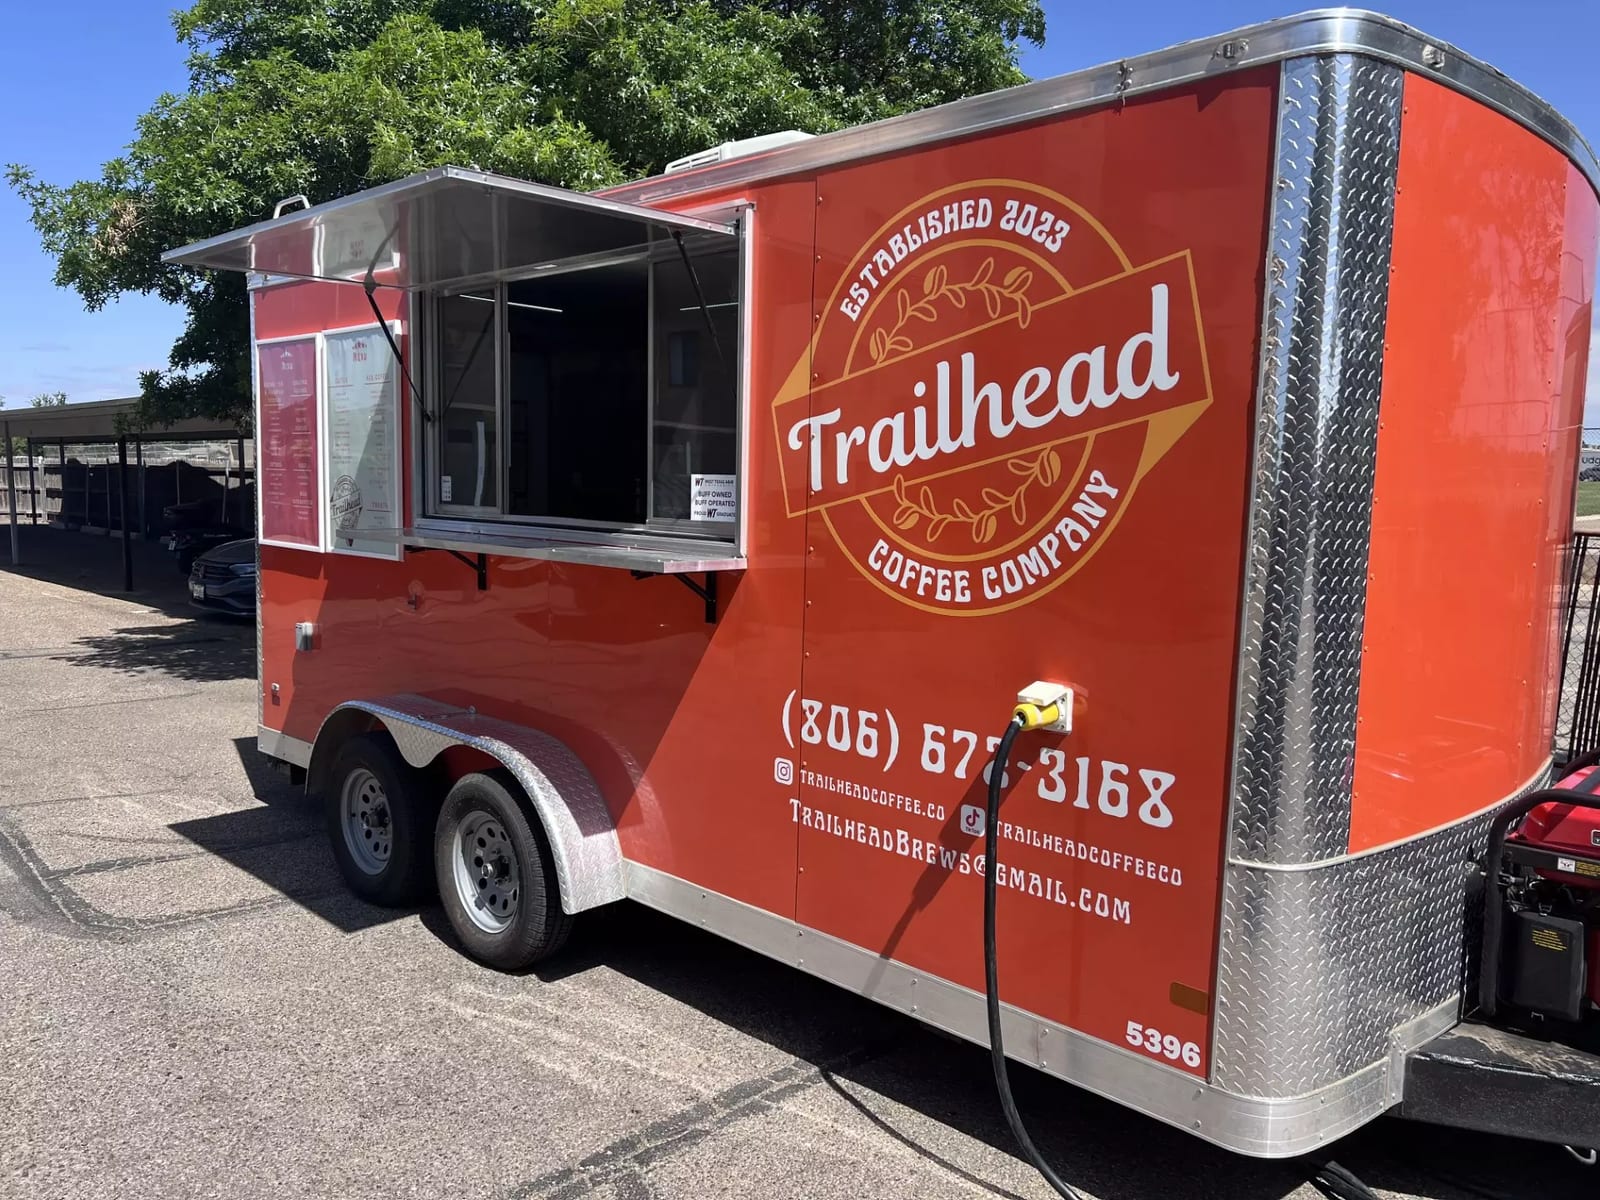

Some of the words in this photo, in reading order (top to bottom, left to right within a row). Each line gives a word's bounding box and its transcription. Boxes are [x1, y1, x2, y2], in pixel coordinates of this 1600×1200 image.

[839, 198, 993, 322] ESTABLISHED
[999, 199, 1071, 253] 2023
[787, 283, 1180, 492] Trailhead
[711, 490, 732, 498] OWNED
[867, 538, 971, 603] COFFEE
[981, 469, 1120, 600] COMPANY
[781, 689, 900, 773] (806)
[799, 769, 946, 821] TRAILHEADCOFFEE.CO
[996, 820, 1183, 887] TRAILHEADCOFFEECO
[1125, 1020, 1201, 1068] 5396
